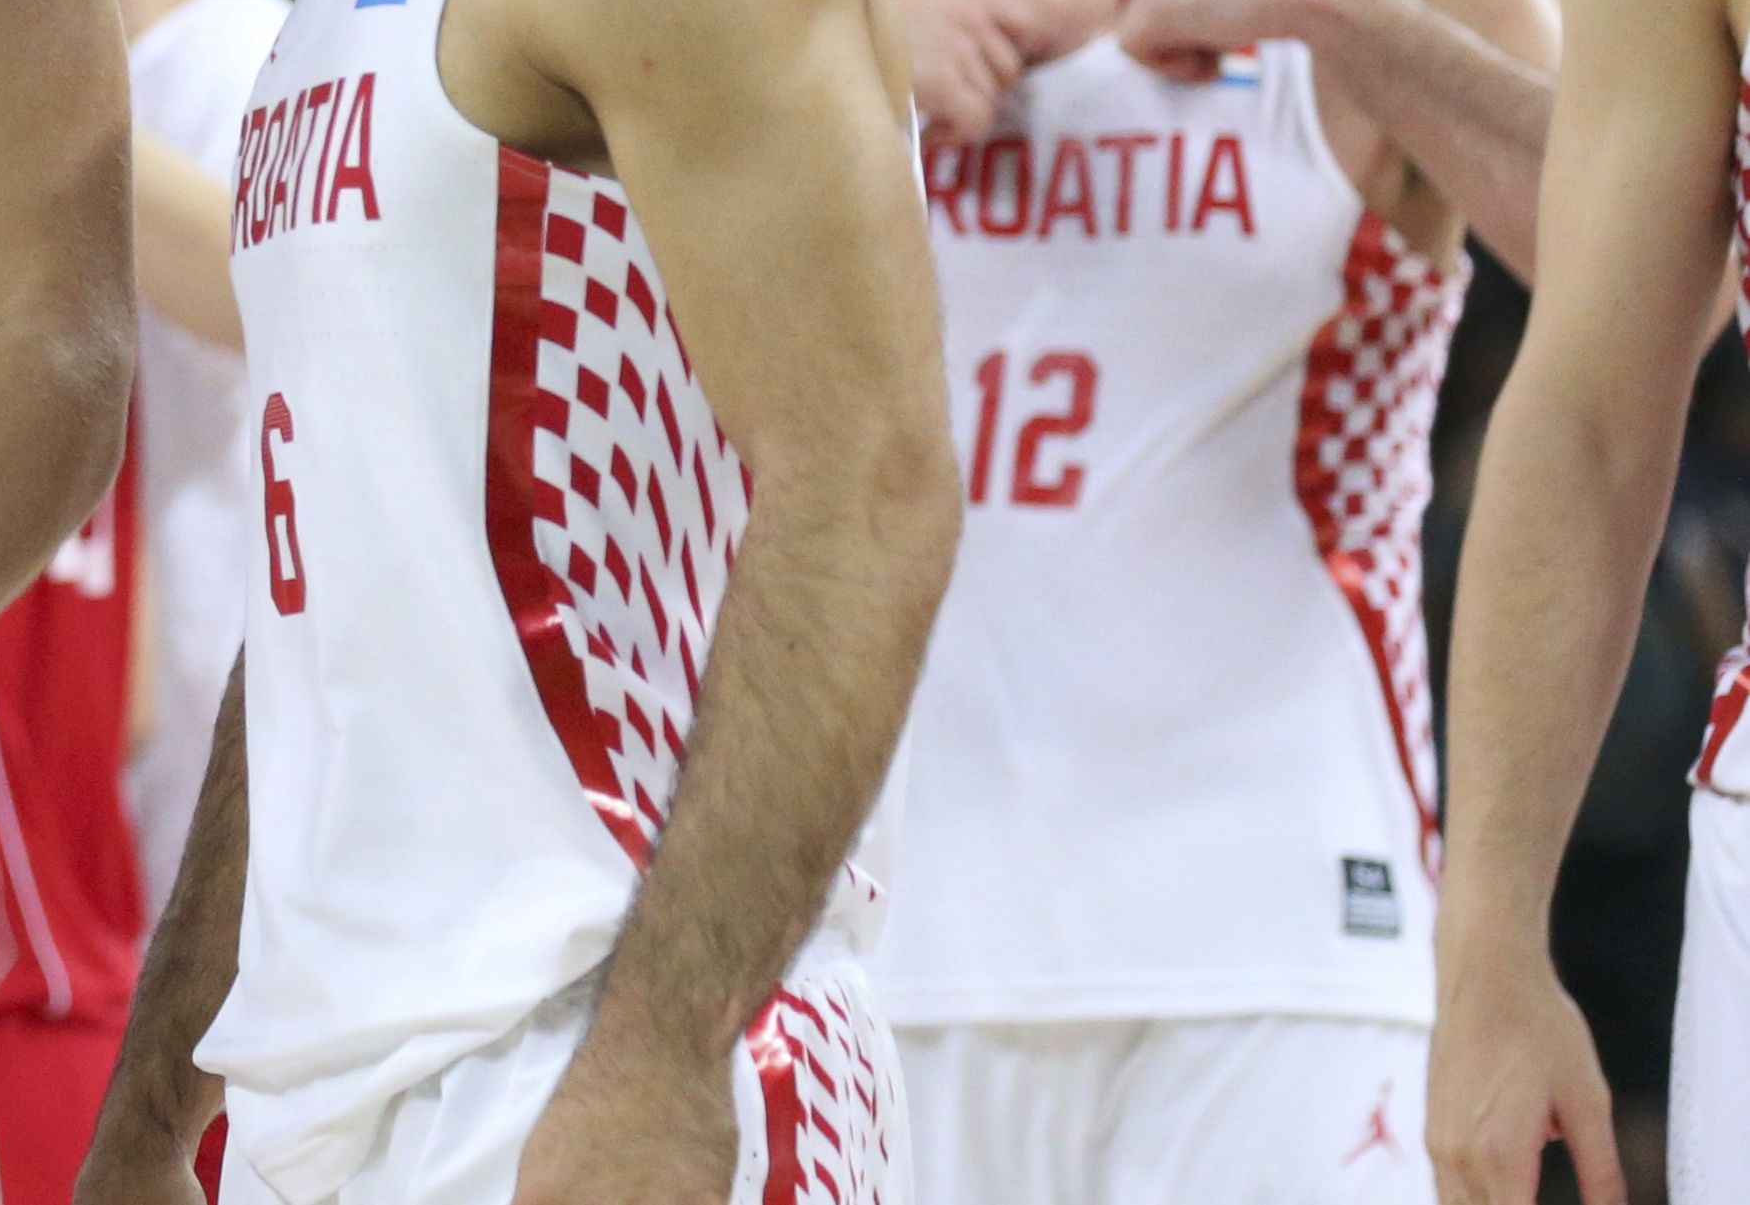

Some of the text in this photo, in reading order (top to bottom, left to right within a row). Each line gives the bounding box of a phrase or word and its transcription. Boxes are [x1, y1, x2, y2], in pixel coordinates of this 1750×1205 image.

[920, 129, 1254, 240] ROATIA
[260, 391, 307, 617] 6
[968, 348, 1100, 509] 12
